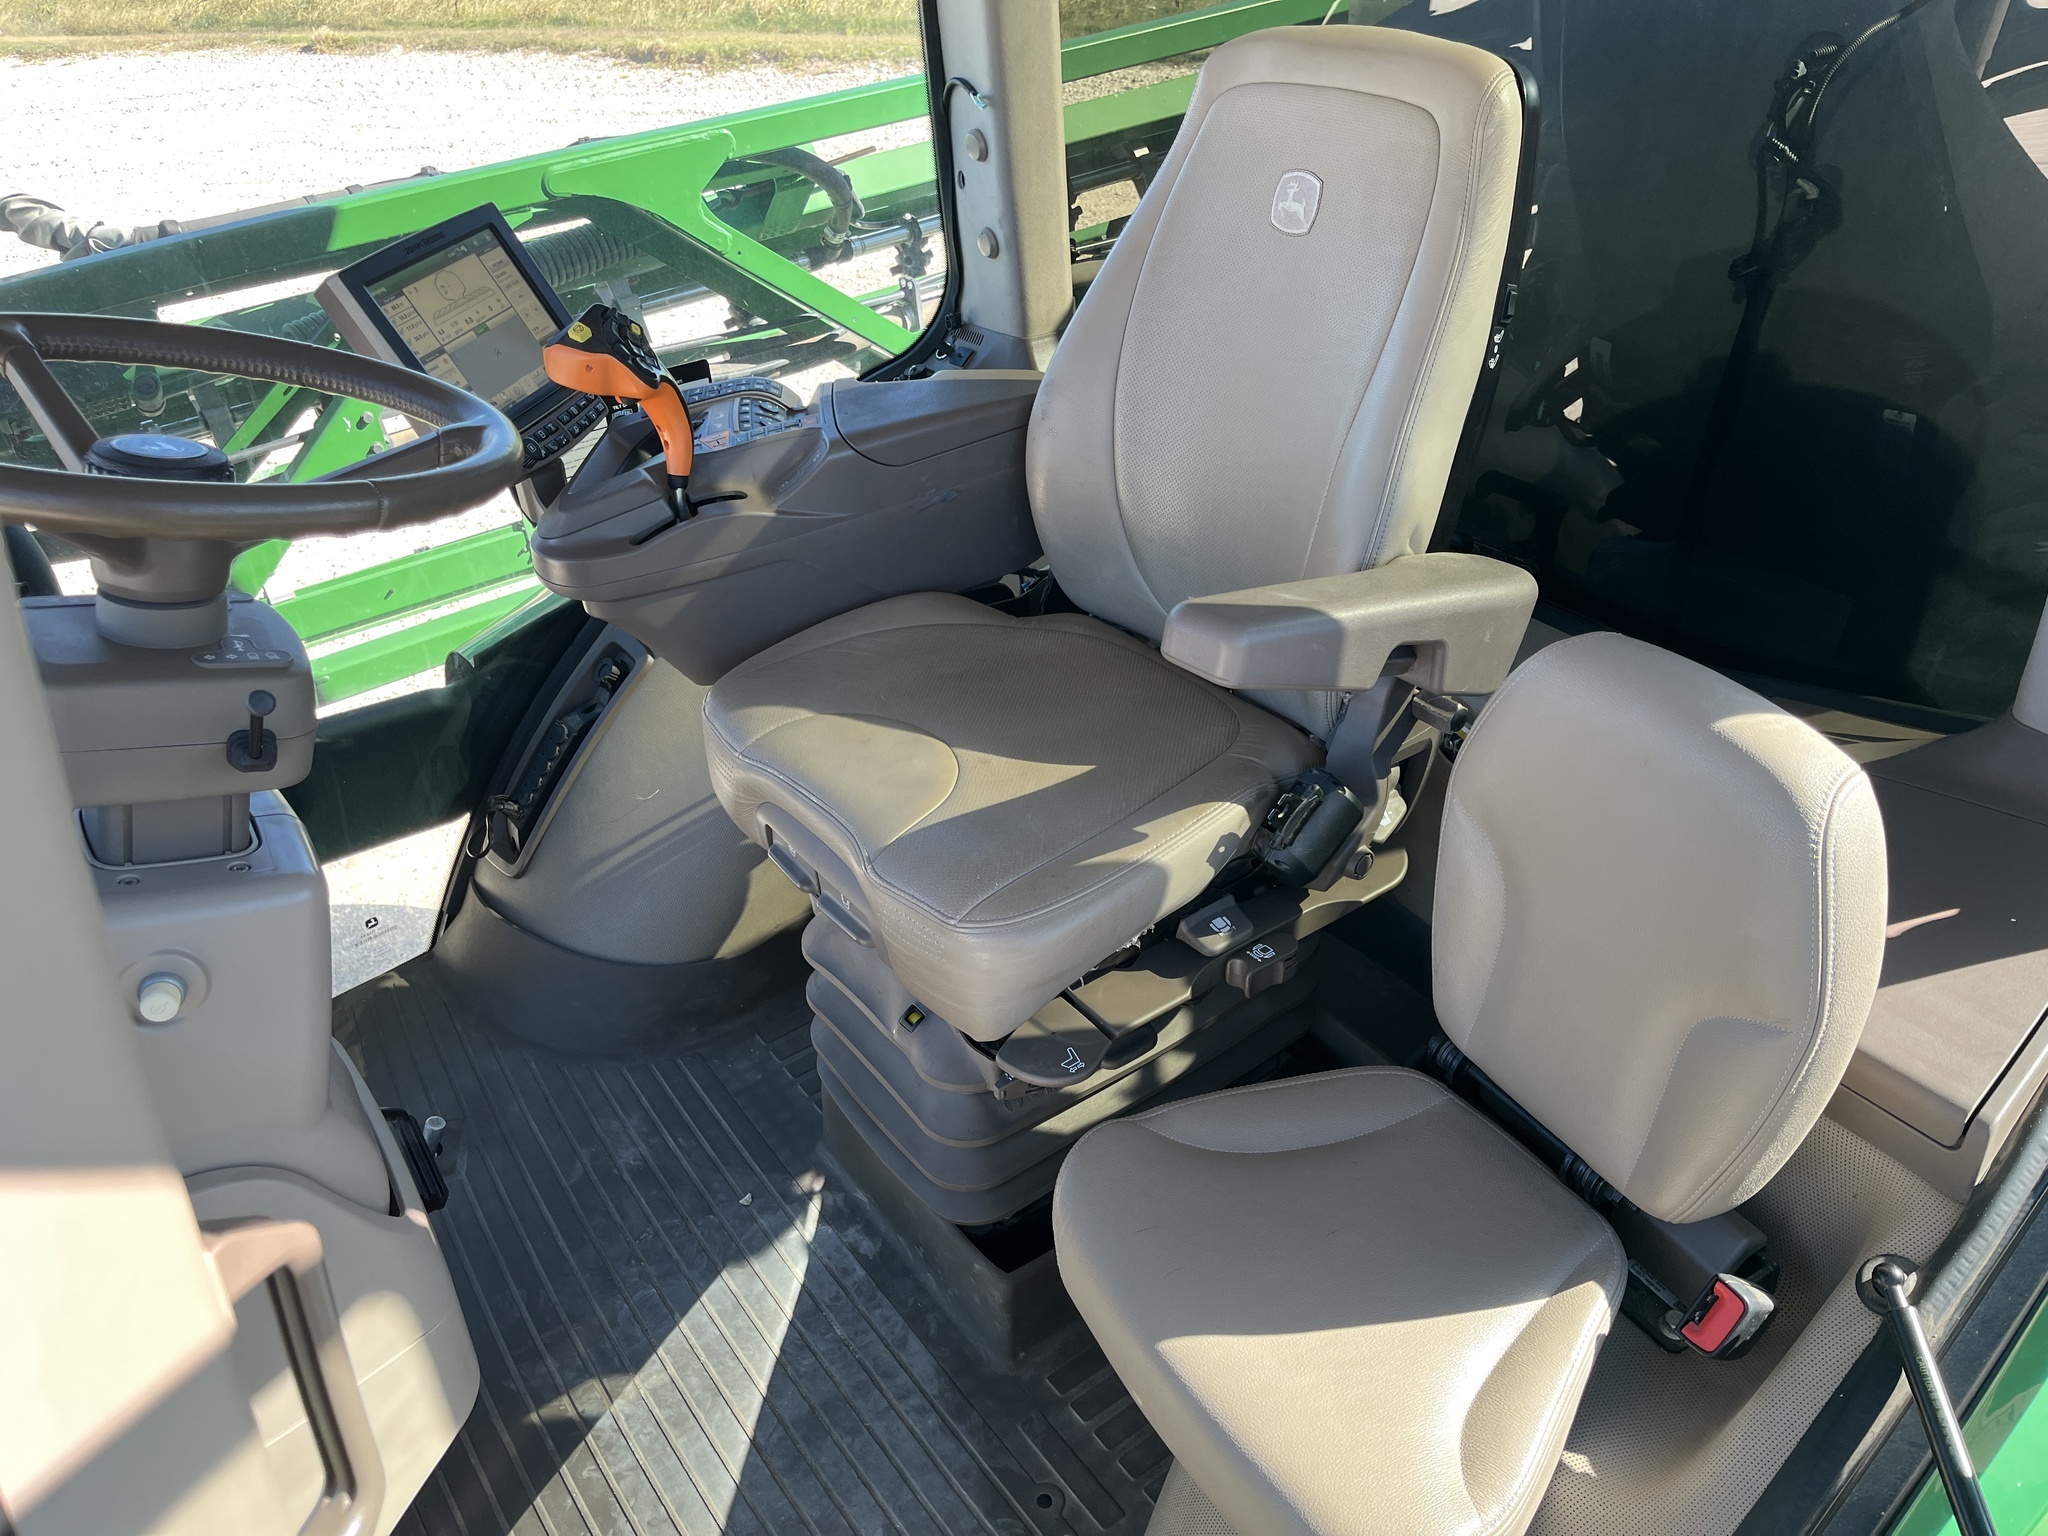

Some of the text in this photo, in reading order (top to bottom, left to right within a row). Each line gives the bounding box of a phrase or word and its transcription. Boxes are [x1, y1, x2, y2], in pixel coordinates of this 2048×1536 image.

[404, 231, 446, 255] JOHN DEERE
[1915, 1356, 1934, 1392] CAUTION
